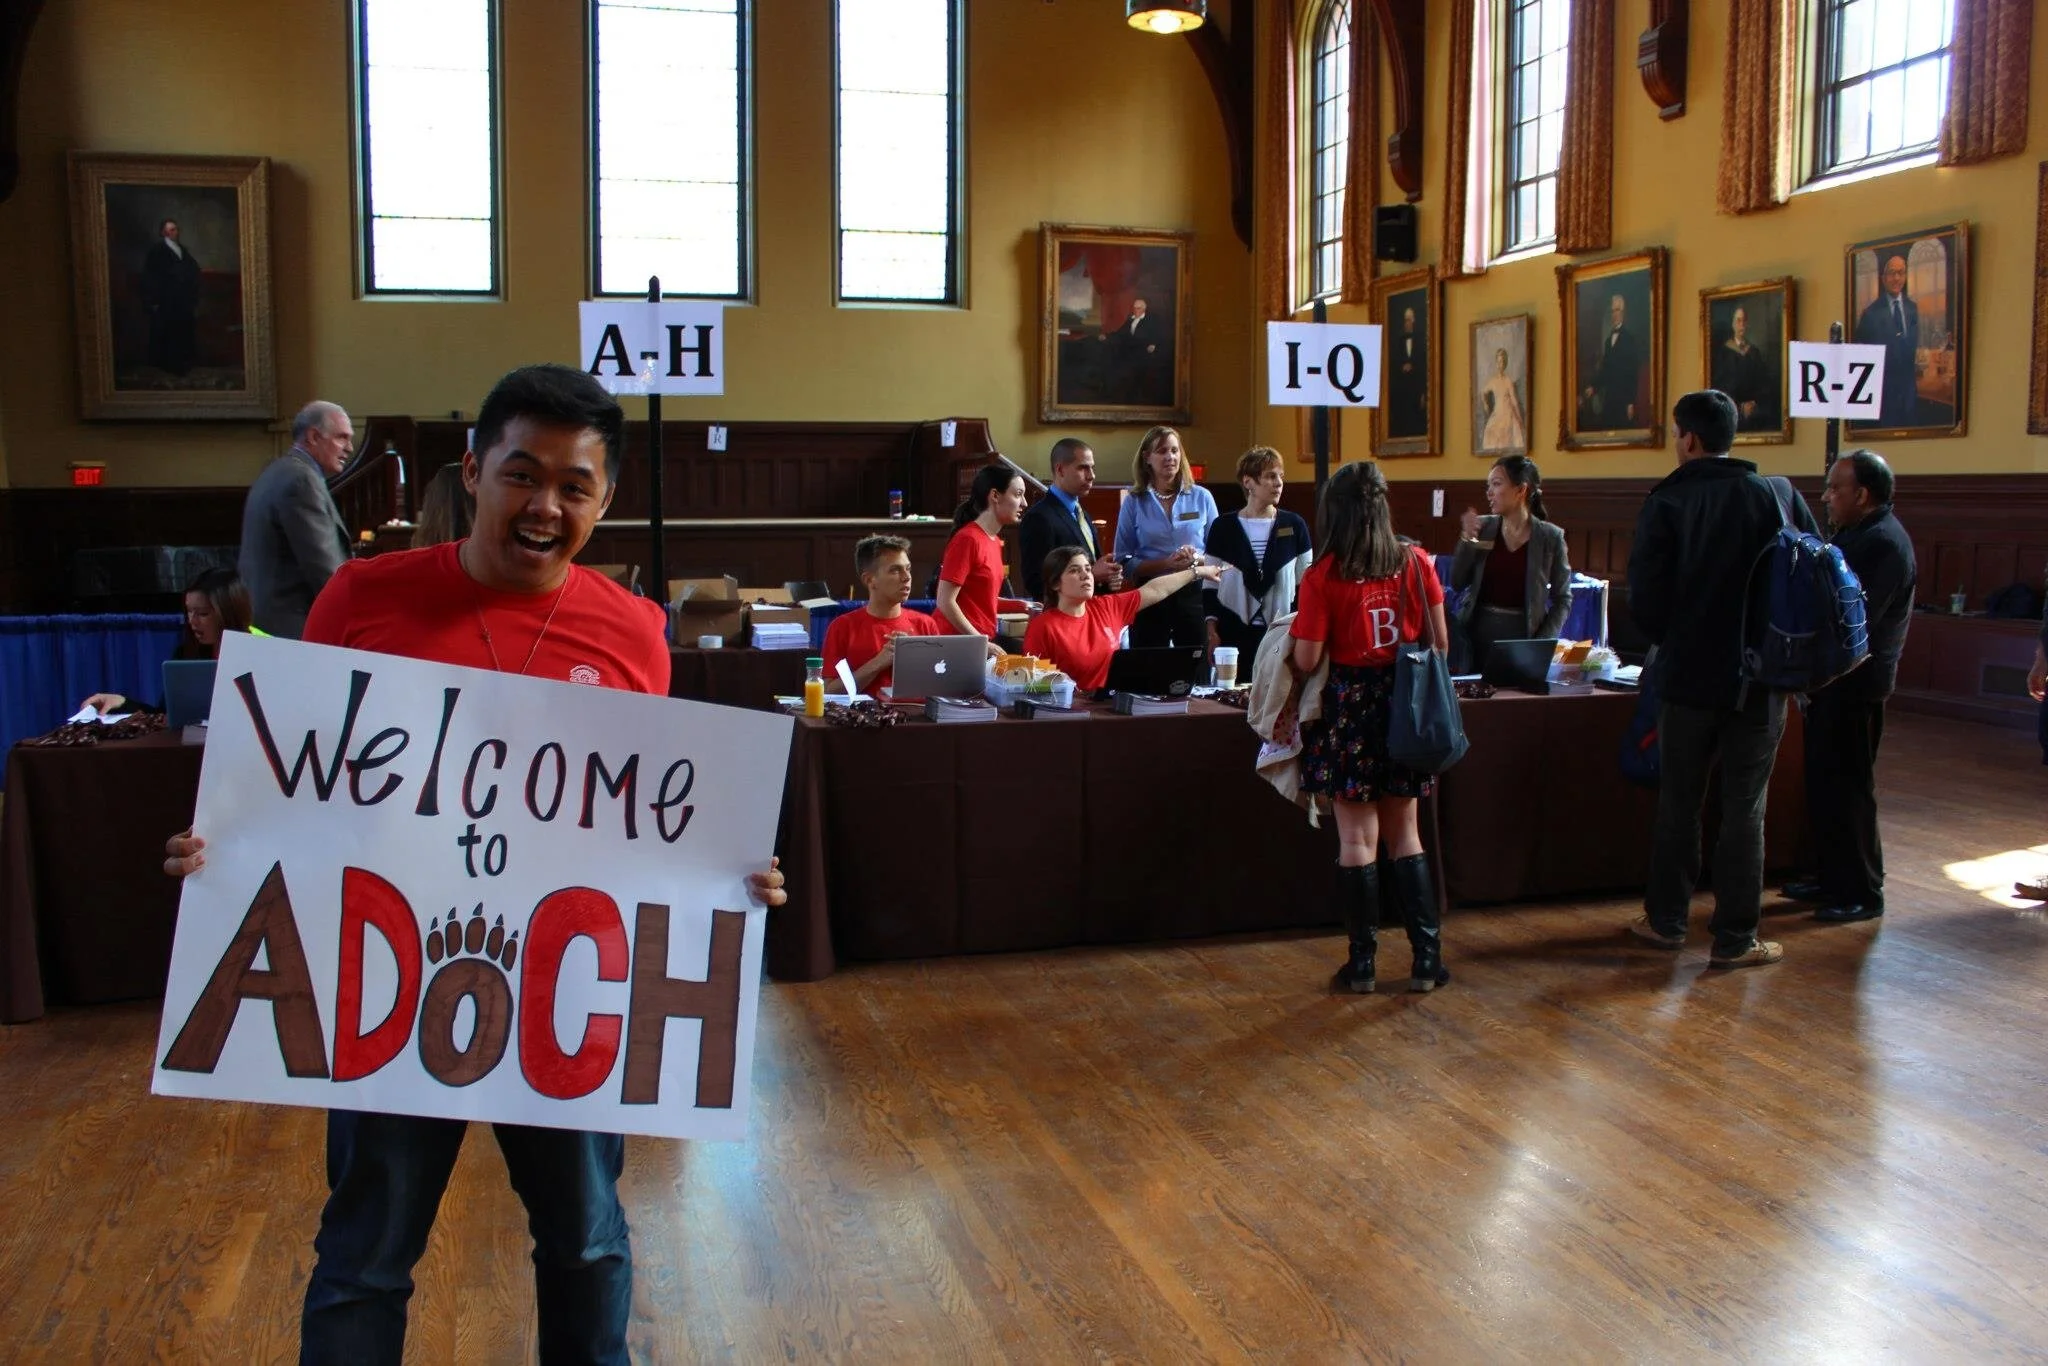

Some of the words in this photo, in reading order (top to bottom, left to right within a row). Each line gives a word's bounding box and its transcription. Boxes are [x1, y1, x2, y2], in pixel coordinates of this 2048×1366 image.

[589, 324, 714, 377] A-H
[1285, 342, 1365, 403] I-Q
[1799, 361, 1876, 404] R-Z
[74, 468, 101, 485] EXIT
[1368, 607, 1399, 649] B
[457, 823, 507, 877] to
